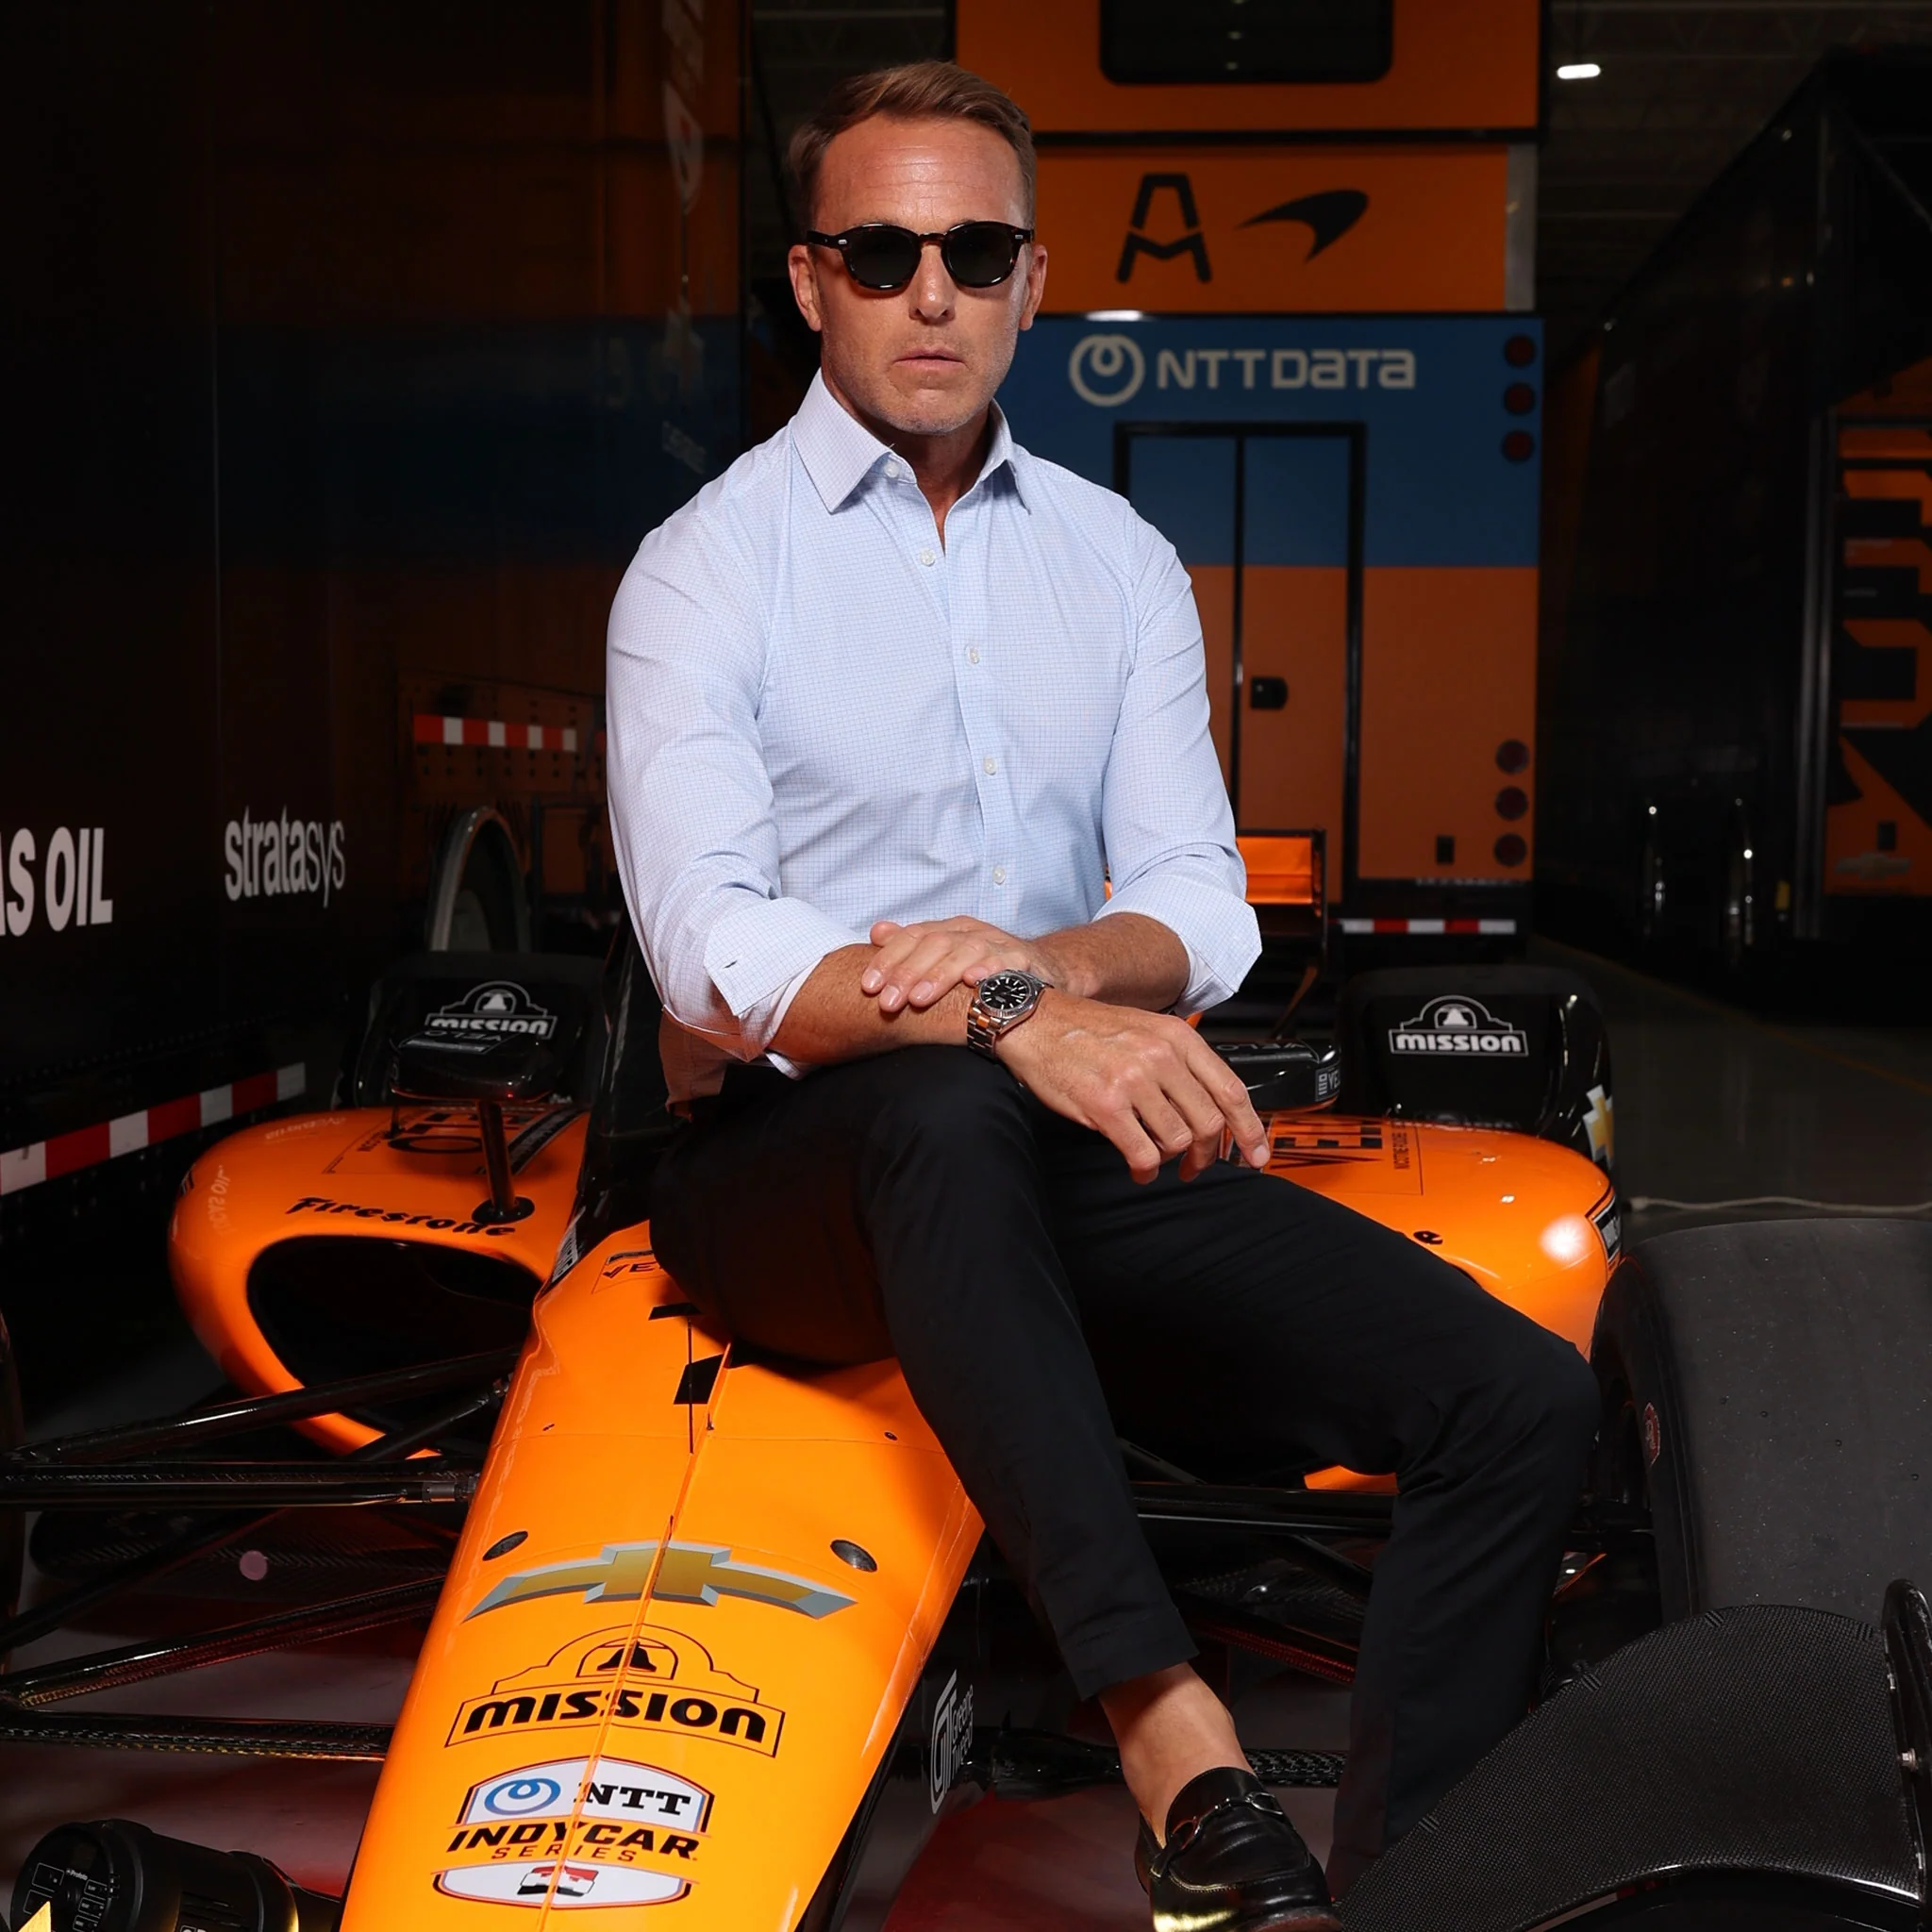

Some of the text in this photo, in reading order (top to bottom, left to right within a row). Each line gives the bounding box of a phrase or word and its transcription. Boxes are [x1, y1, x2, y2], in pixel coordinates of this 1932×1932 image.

[225, 805, 346, 909] stratasys
[45, 826, 113, 932] OIL
[285, 1197, 516, 1236] Firestone
[574, 1782, 691, 1816] NTT
[446, 1822, 699, 1860] INDYCAR
[491, 1845, 637, 1862] SERIES
